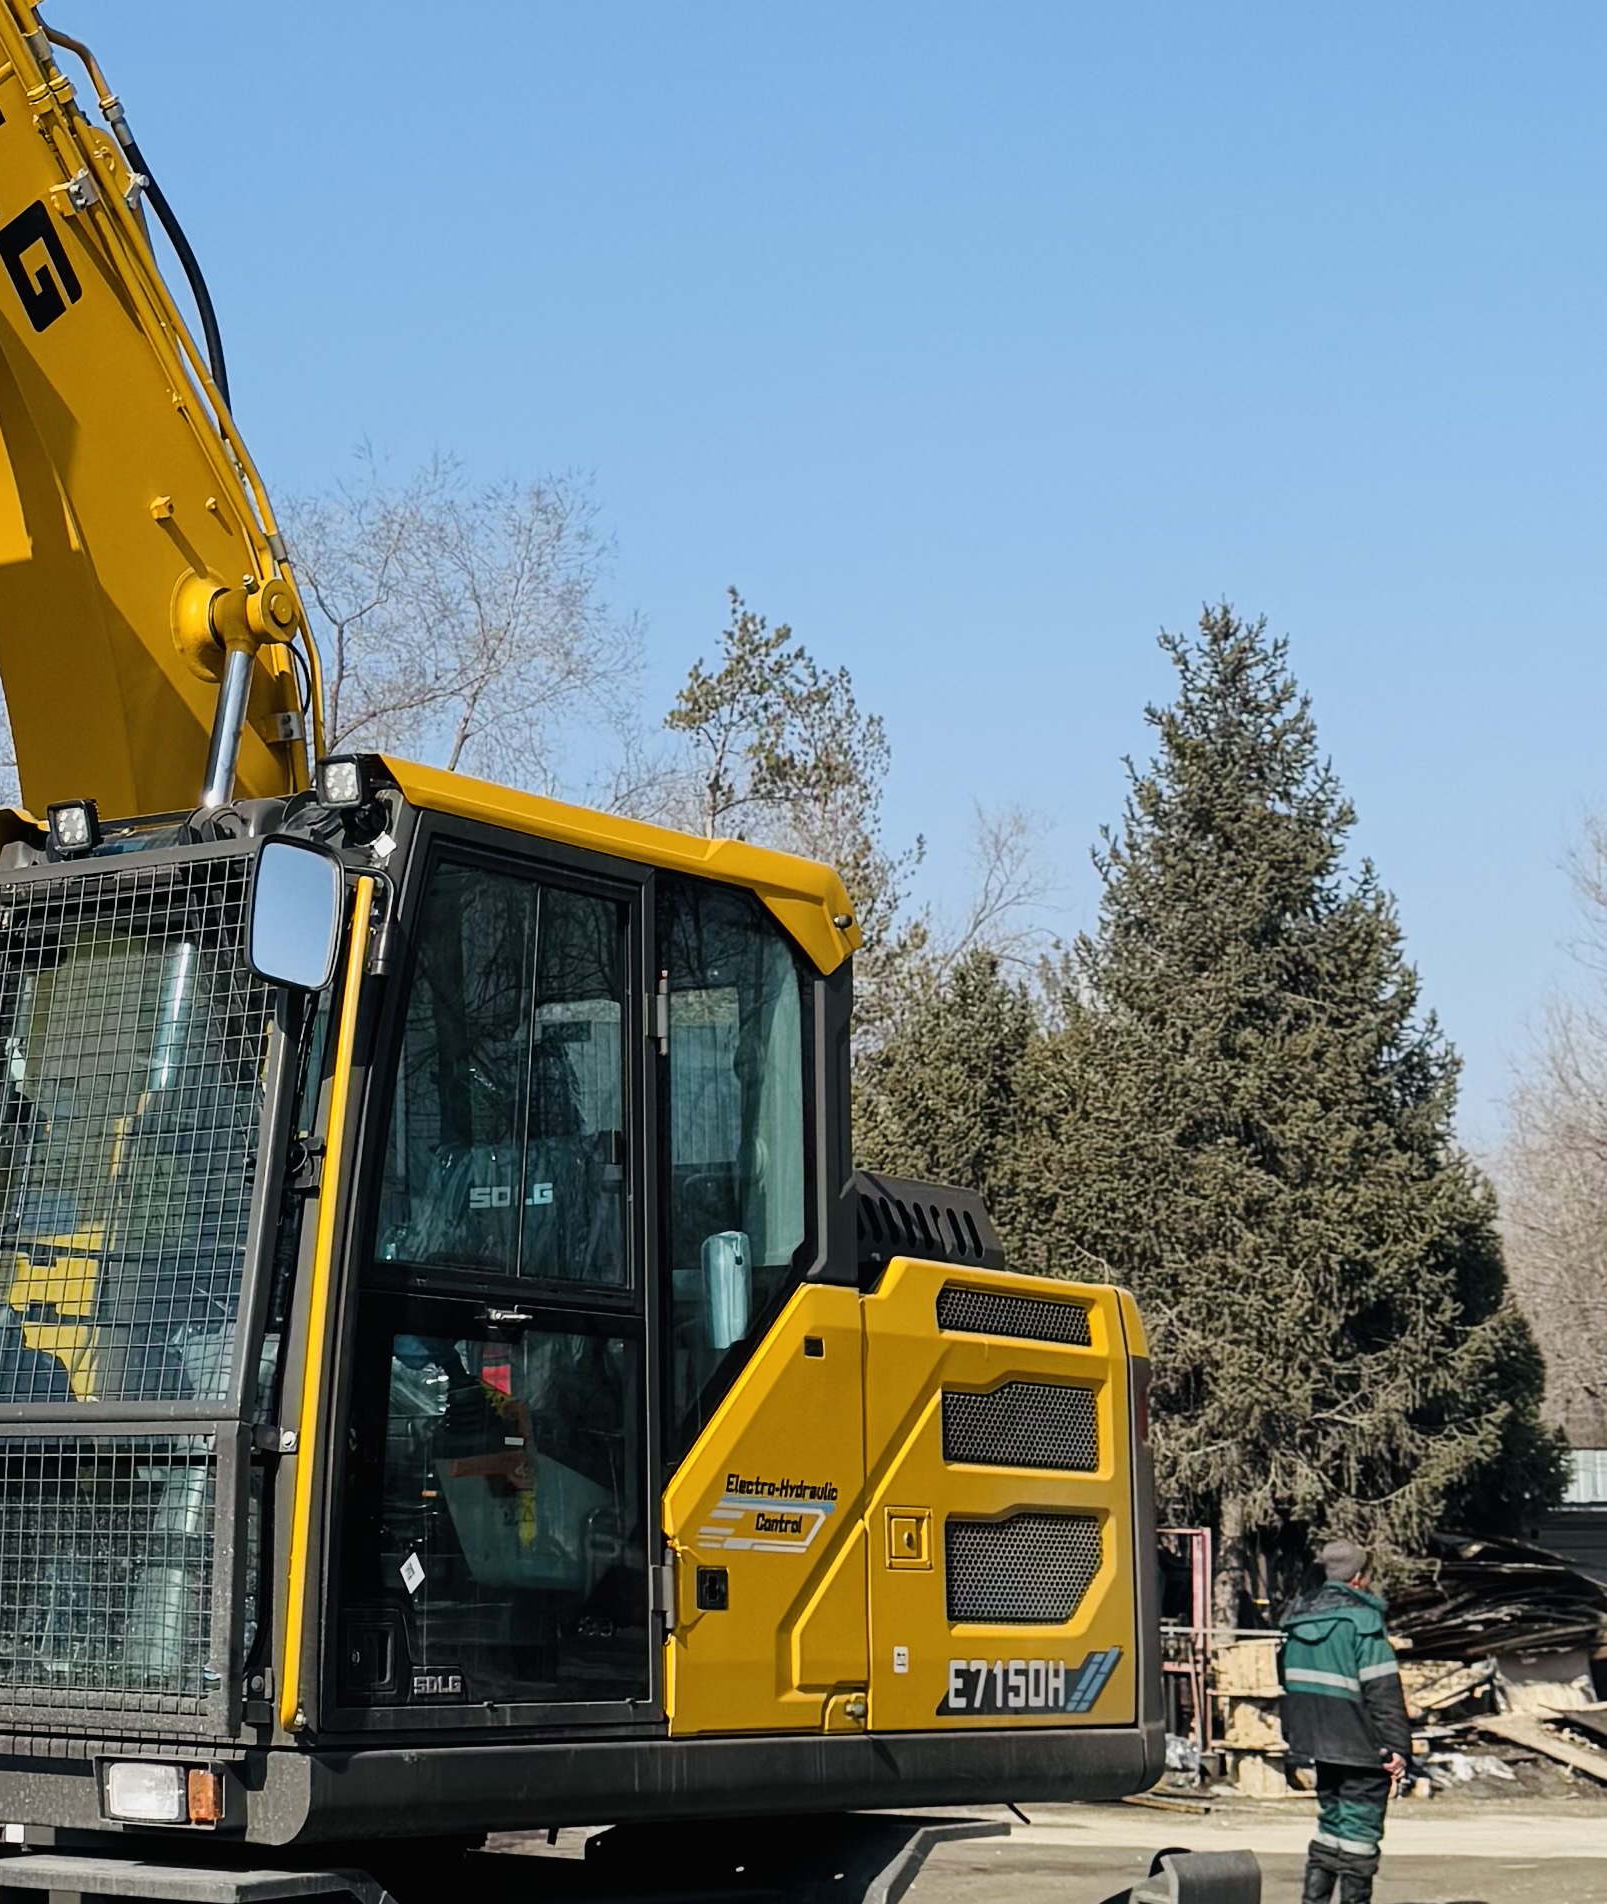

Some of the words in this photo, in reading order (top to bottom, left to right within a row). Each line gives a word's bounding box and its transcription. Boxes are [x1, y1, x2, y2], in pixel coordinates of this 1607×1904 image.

[725, 1472, 839, 1502] Electro-Hydraulic
[755, 1512, 803, 1534] Control
[413, 1675, 462, 1694] SDLG
[948, 1658, 1066, 1709] E7150H
